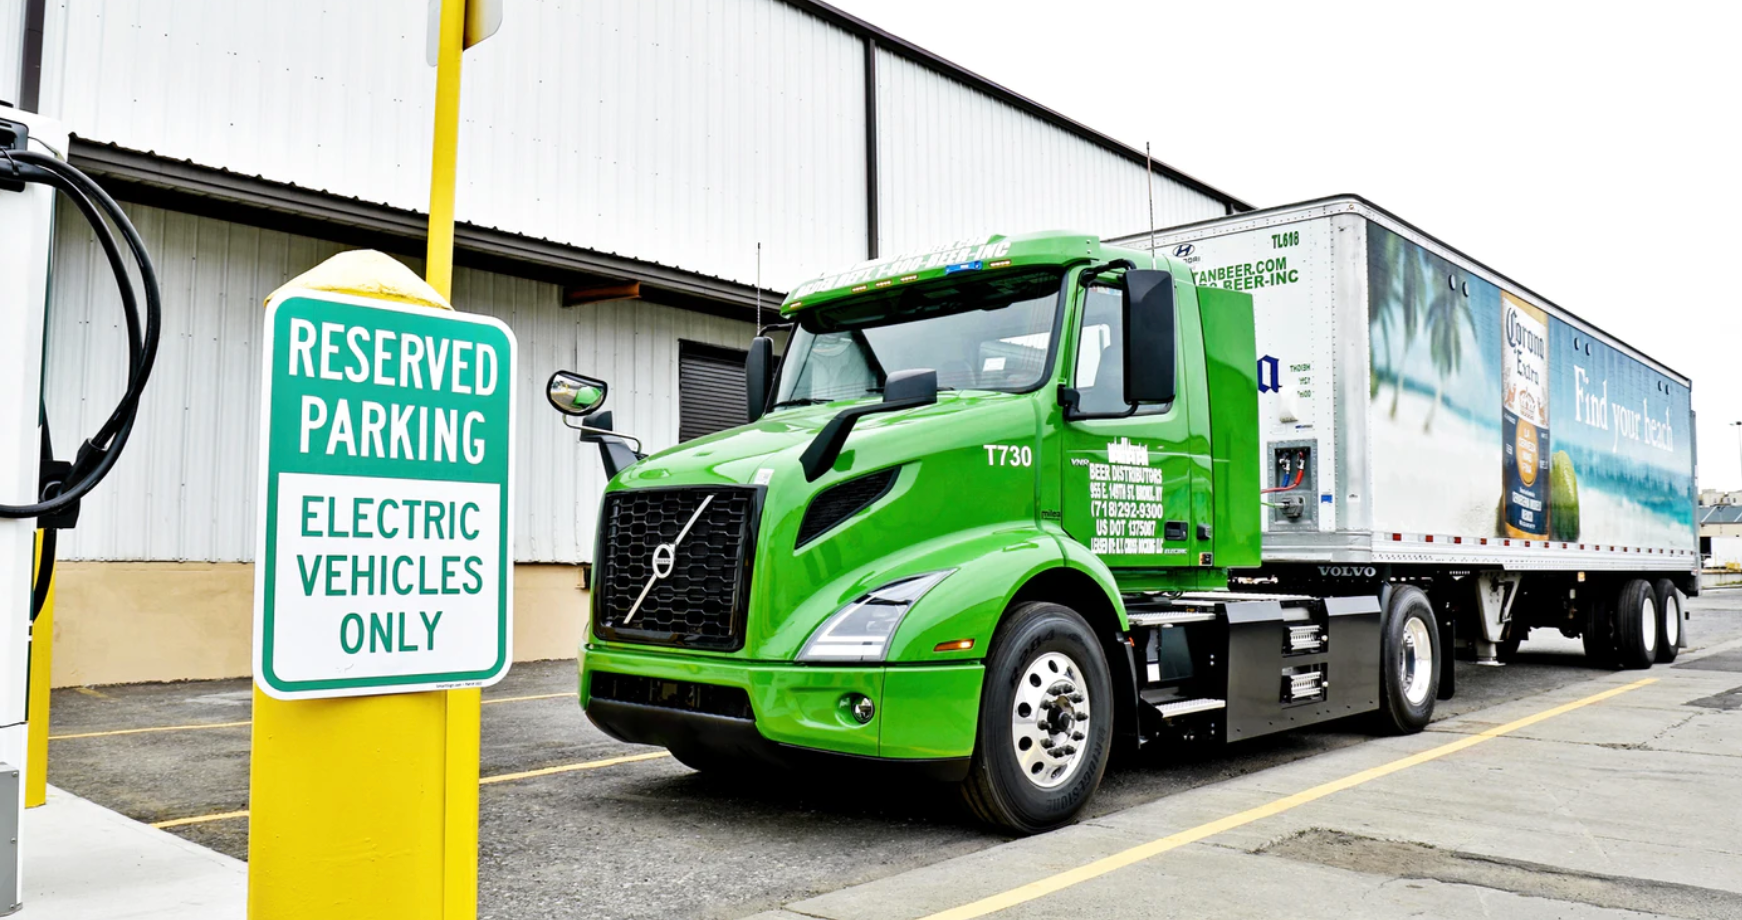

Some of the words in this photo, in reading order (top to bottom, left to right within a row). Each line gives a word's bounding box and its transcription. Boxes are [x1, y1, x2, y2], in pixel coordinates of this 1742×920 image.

[1193, 256, 1287, 284] TANBEER.COM
[1223, 269, 1299, 290] BEER-INC
[1505, 307, 1545, 360] Corona
[288, 317, 499, 396] RESERVED
[1513, 348, 1539, 386] Extra
[1573, 364, 1609, 431] Find
[1611, 402, 1641, 454] your
[1643, 397, 1674, 452] beach
[299, 394, 486, 465] PARKING
[983, 444, 1032, 468] T730
[1089, 463, 1111, 481] BEER
[1111, 464, 1163, 485] DISTRIBUTORS
[301, 495, 481, 541] ELECTRIC
[1091, 500, 1164, 519] (718)292-9300
[1096, 519, 1108, 536] US
[1109, 519, 1126, 536] DOT
[296, 554, 484, 597] VEHICLES
[1318, 565, 1377, 577] VOLVO
[339, 610, 444, 655] ONLY
